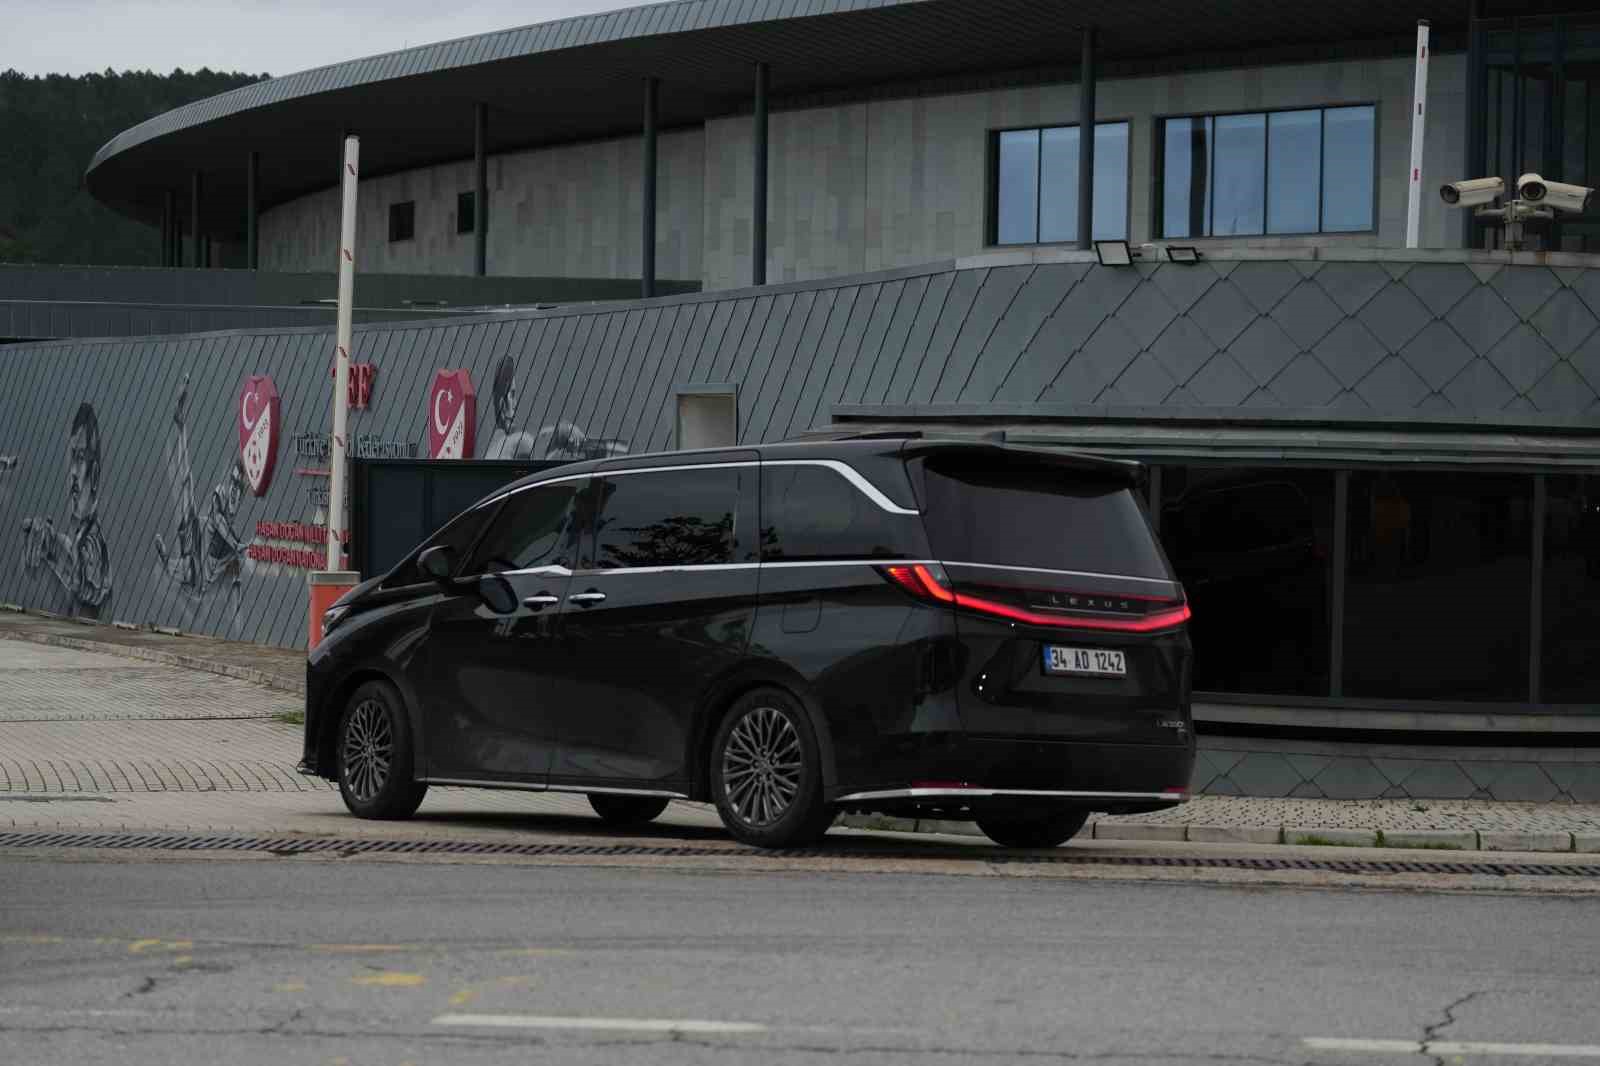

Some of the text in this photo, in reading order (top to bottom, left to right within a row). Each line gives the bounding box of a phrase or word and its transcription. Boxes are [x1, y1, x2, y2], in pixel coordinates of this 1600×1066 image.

[329, 363, 374, 407] FF
[1051, 594, 1128, 608] LEXUS
[1051, 649, 1067, 668] 34
[1094, 651, 1123, 672] 1242
